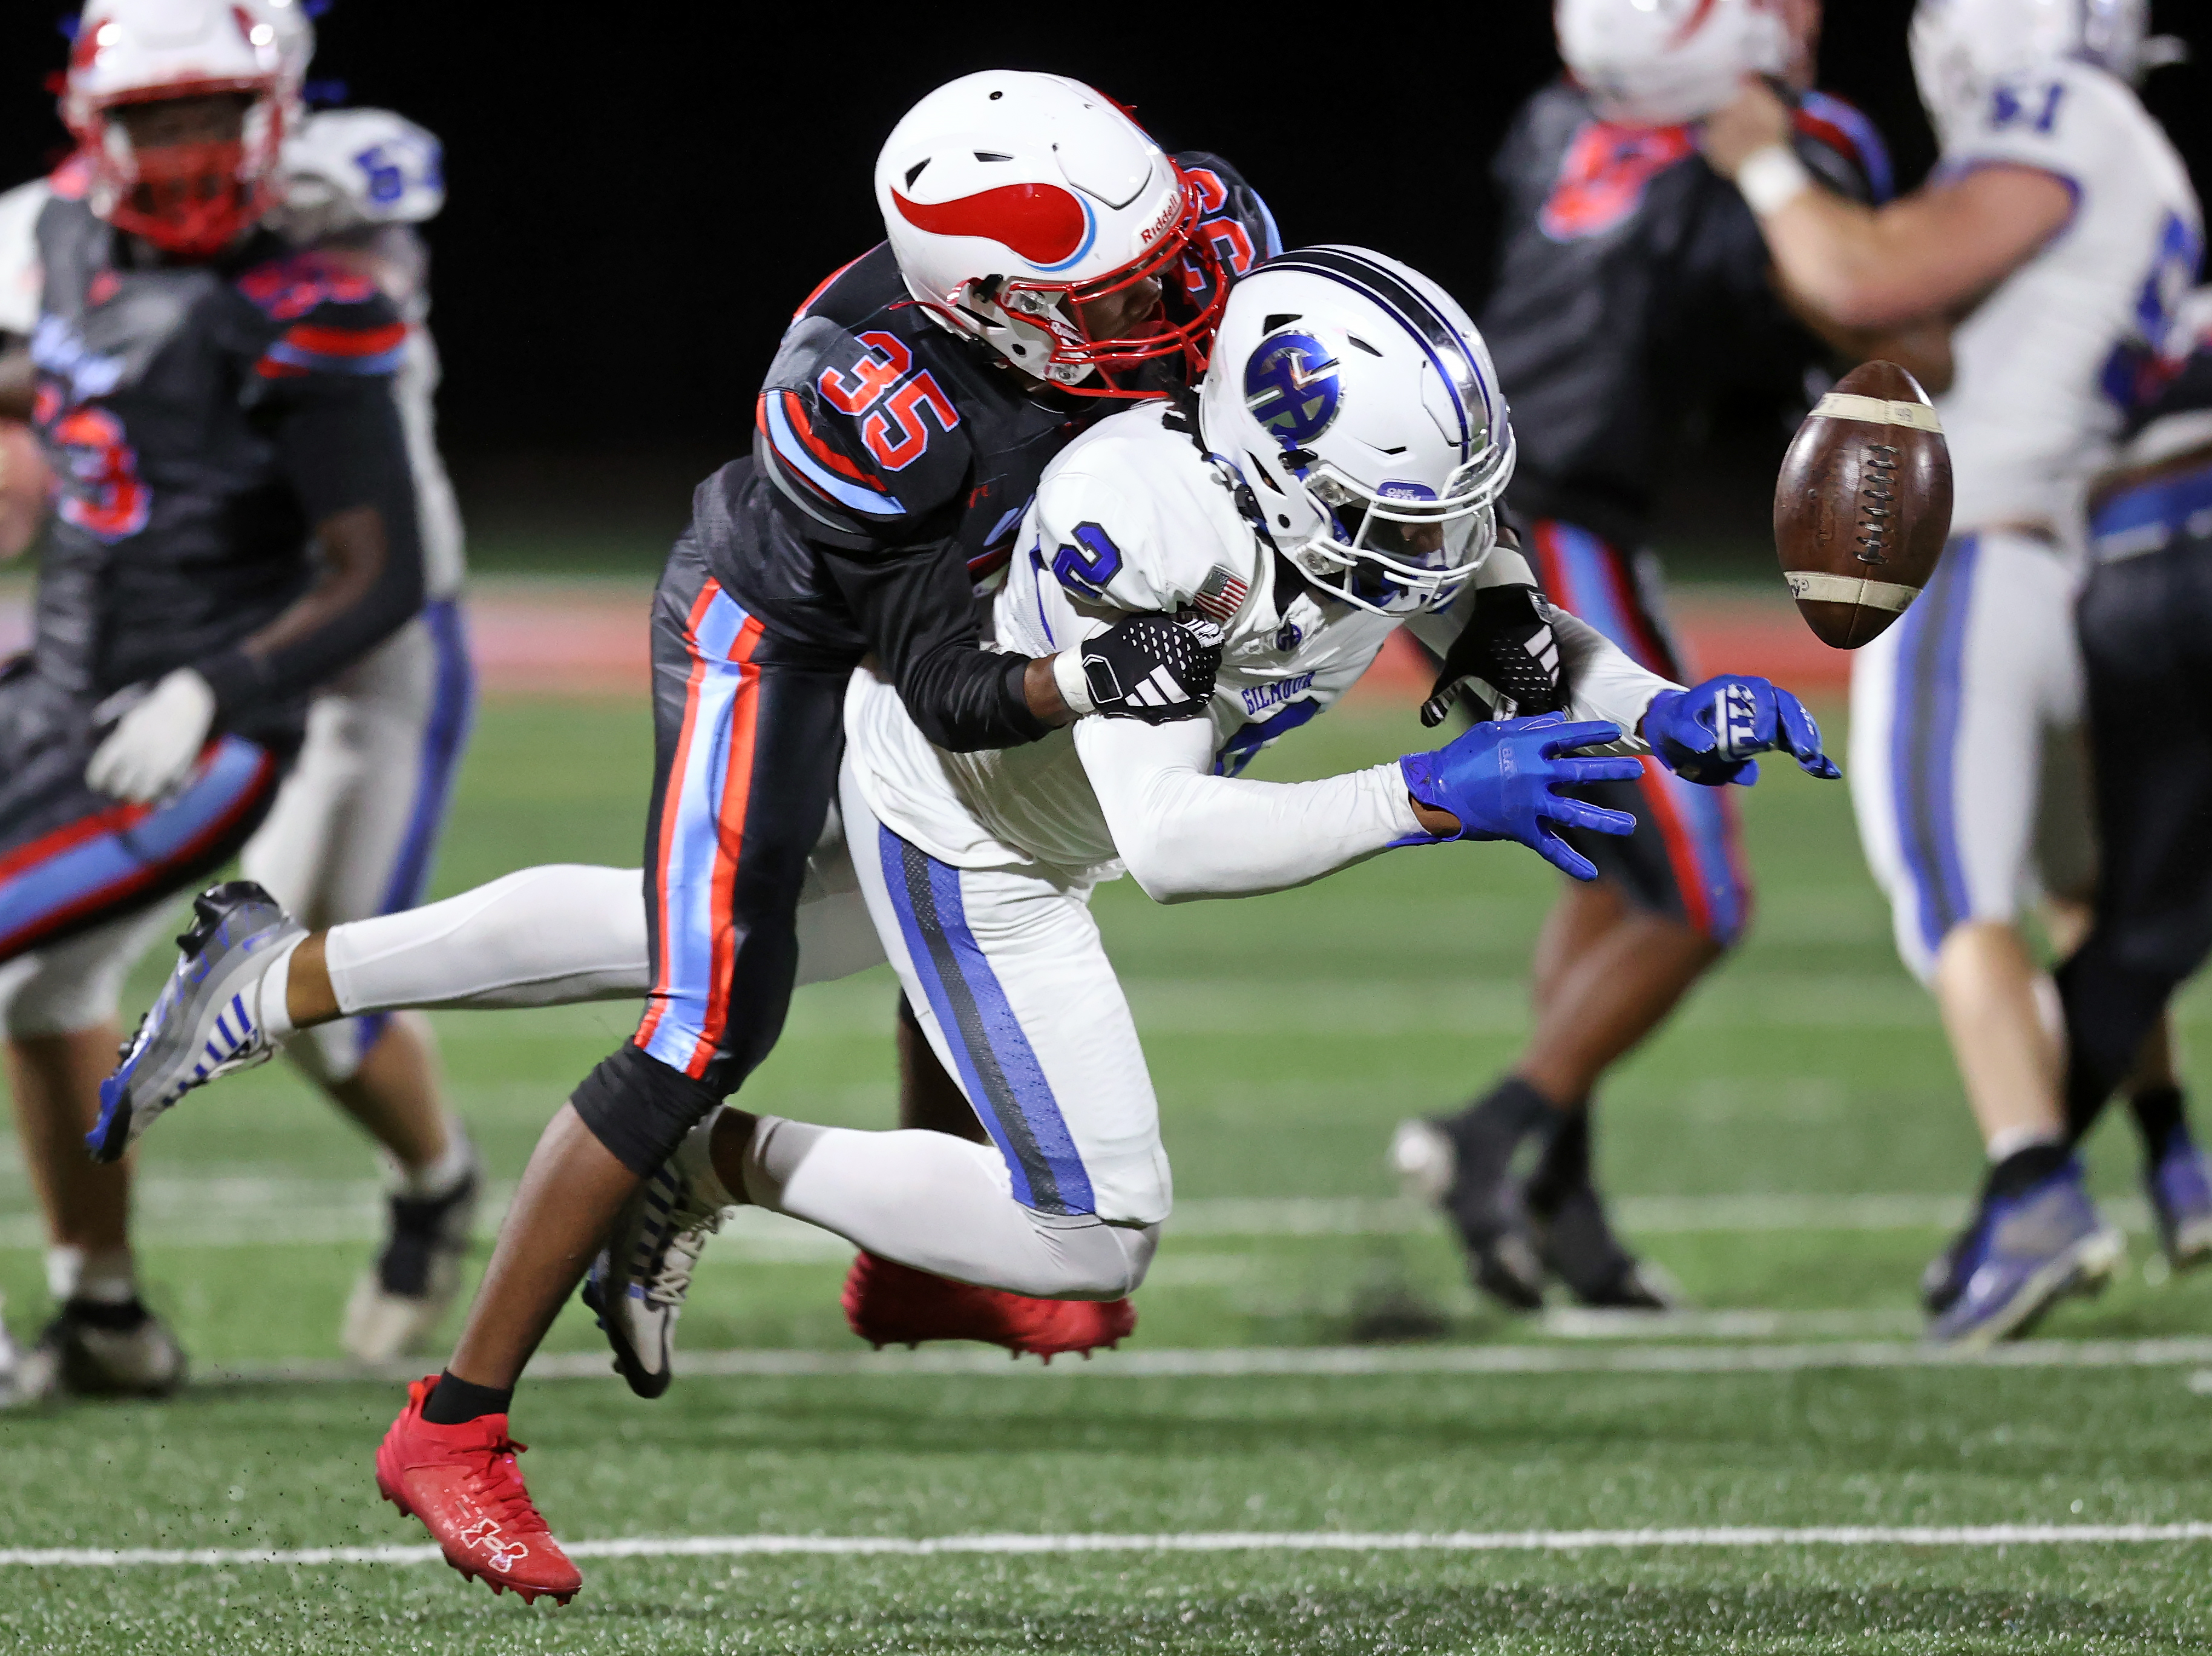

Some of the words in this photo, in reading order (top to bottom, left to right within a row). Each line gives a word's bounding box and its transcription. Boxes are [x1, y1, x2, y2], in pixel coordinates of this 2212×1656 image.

[1140, 194, 1179, 243] Riddell
[818, 330, 961, 472] 35
[1052, 521, 1123, 599] 2
